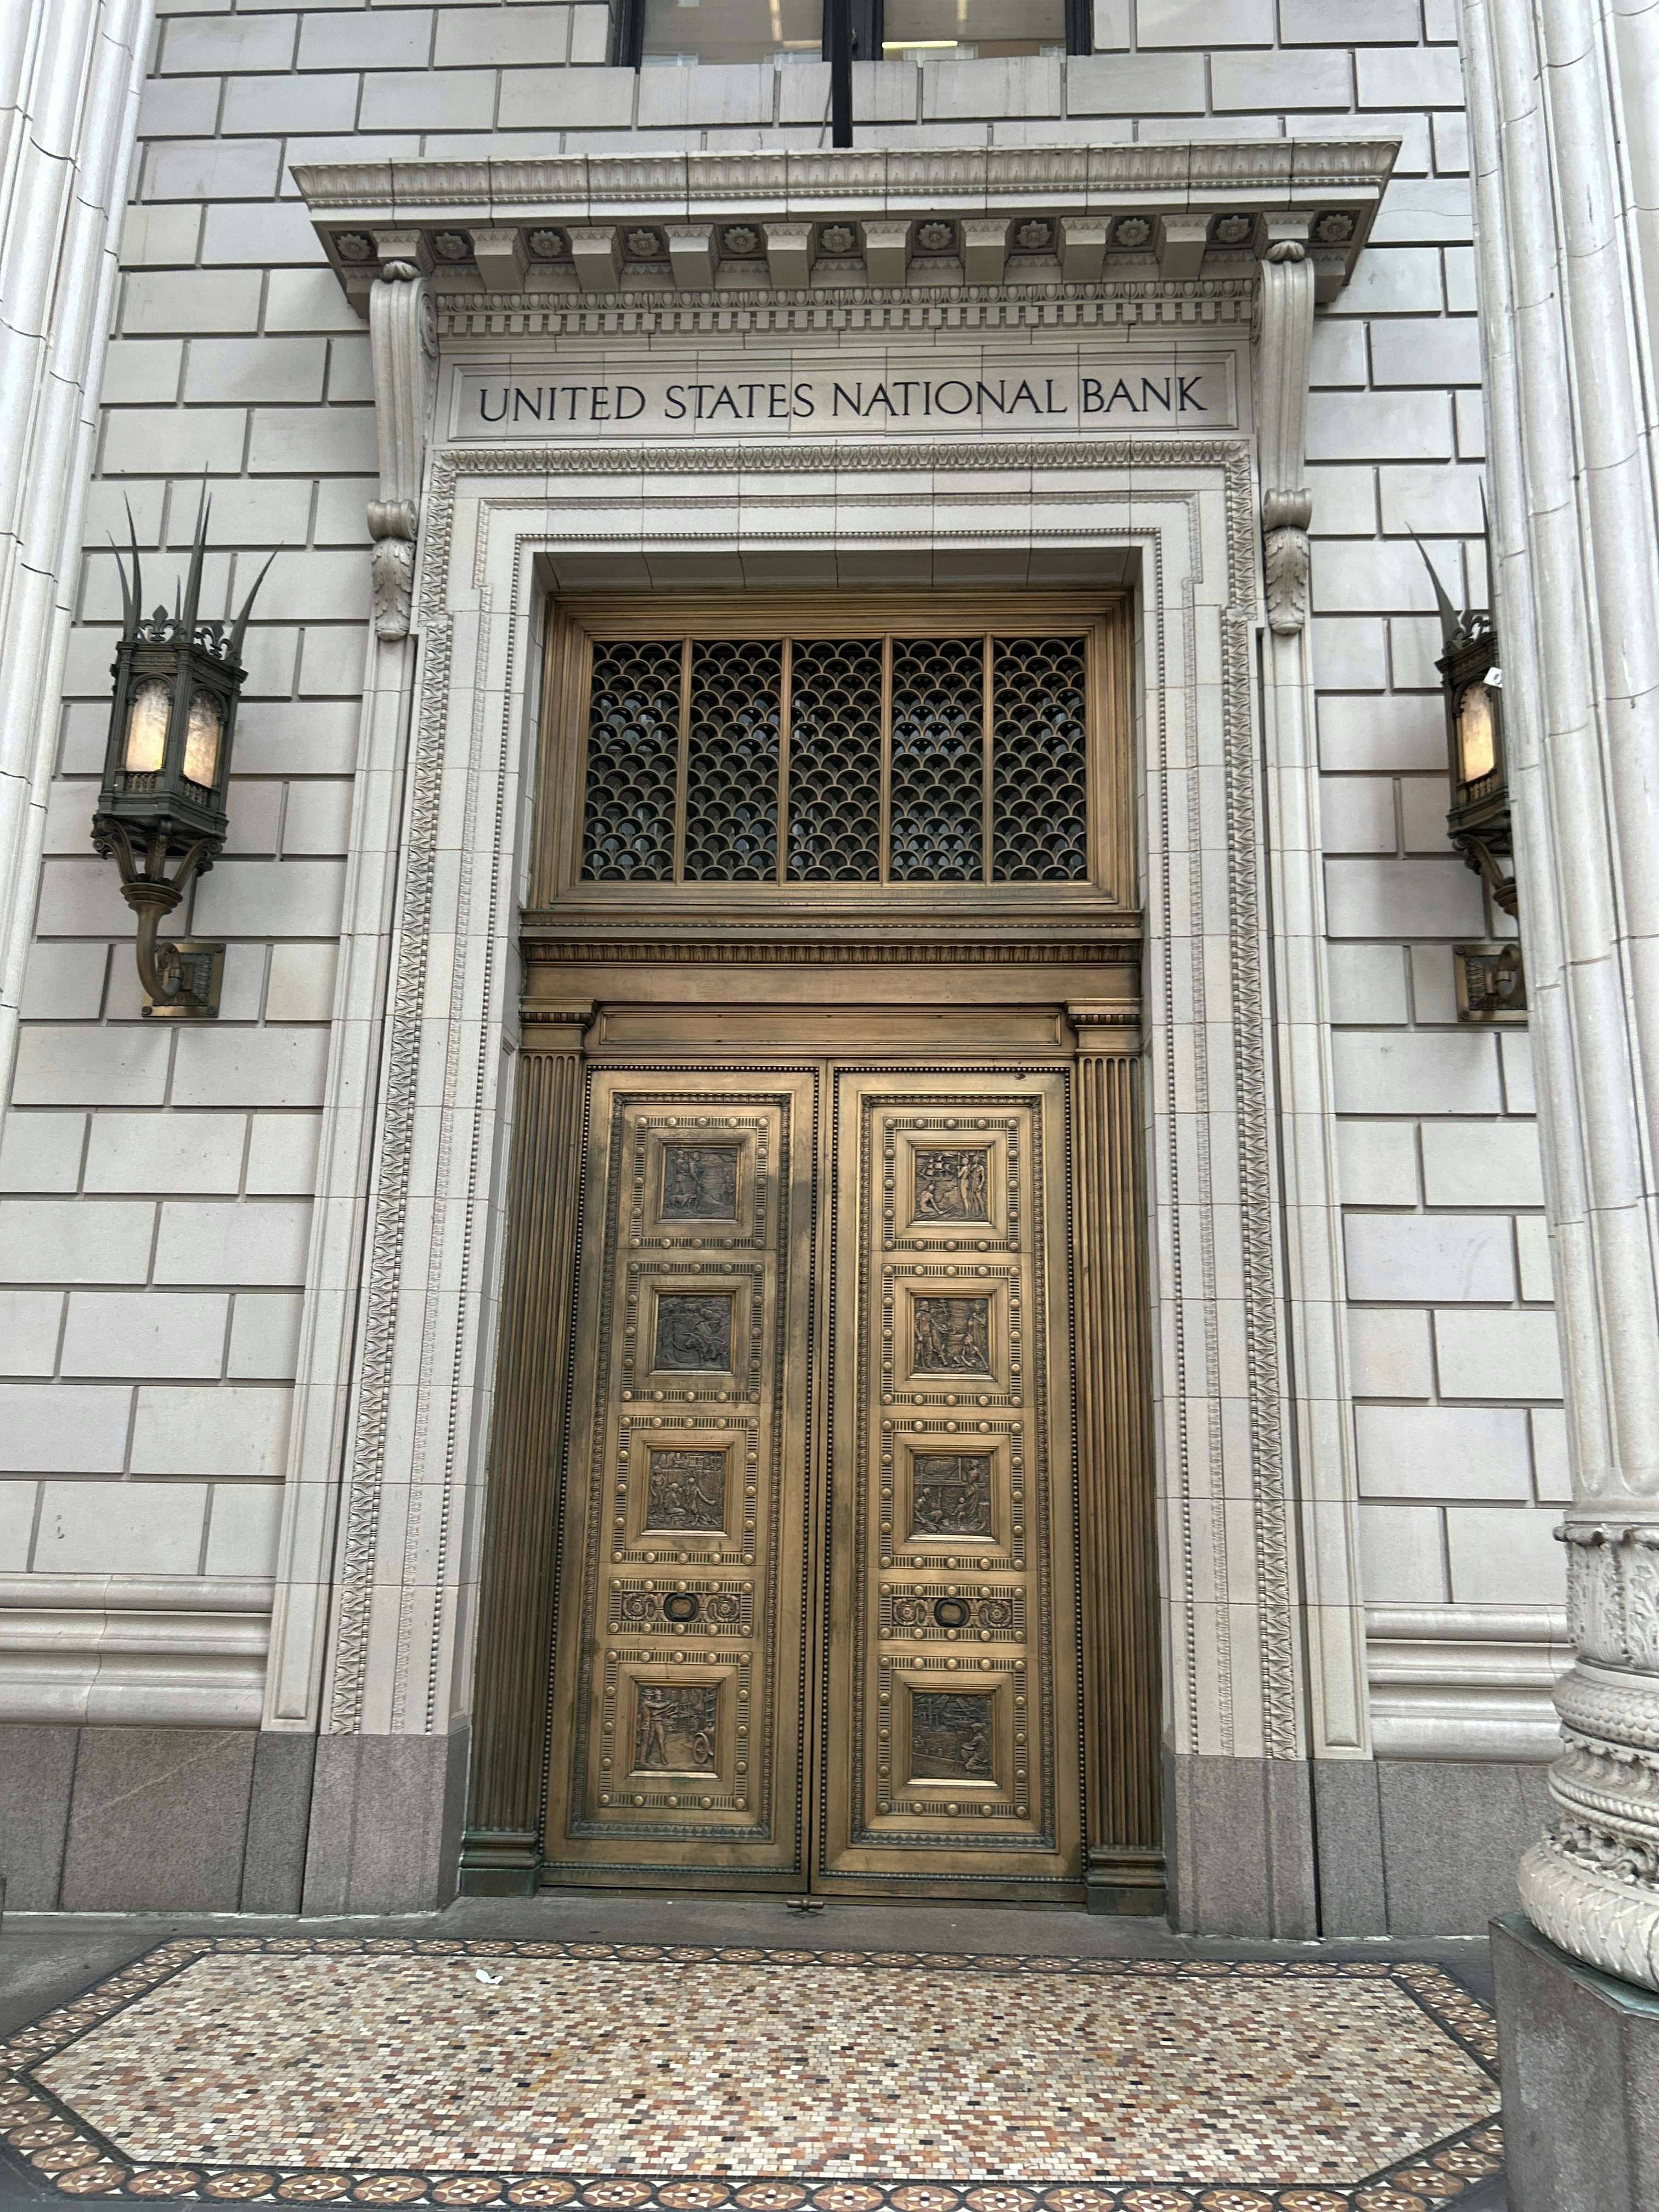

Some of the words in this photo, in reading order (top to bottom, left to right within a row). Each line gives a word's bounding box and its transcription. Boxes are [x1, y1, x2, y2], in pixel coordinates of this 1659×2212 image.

[480, 386, 646, 422] UNITED
[664, 383, 815, 419] STATES
[832, 379, 1067, 416] NATIONAL
[1081, 376, 1207, 413] BANK
